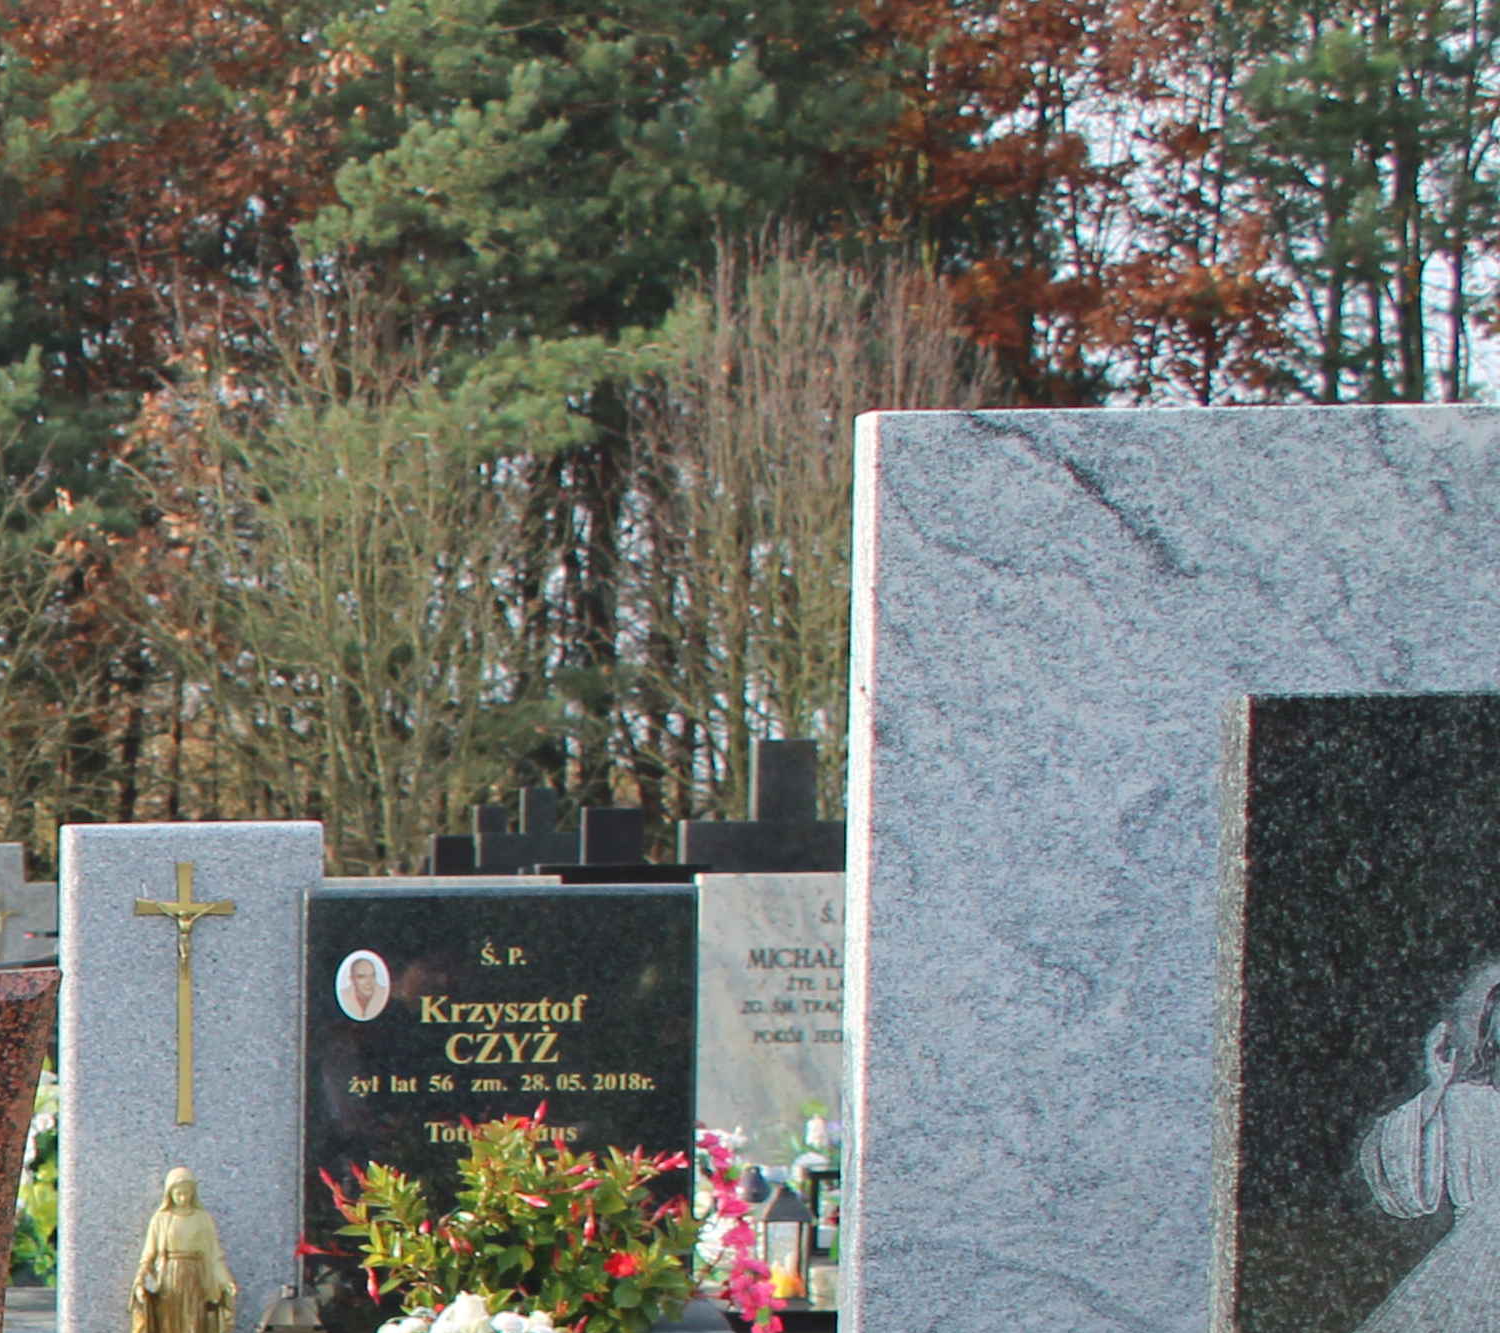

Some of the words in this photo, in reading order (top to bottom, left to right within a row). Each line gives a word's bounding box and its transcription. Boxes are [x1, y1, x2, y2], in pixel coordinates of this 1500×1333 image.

[507, 946, 528, 966] P.
[419, 993, 589, 1031] Krzysztof
[444, 1025, 561, 1065] CZYŻ
[348, 1075, 380, 1098] żył
[390, 1075, 418, 1093] lat
[428, 1074, 455, 1093] 56
[470, 1079, 509, 1092] zm.
[520, 1073, 552, 1093] 28.
[555, 1073, 588, 1092] 05.
[592, 1072, 657, 1092] 2018r.
